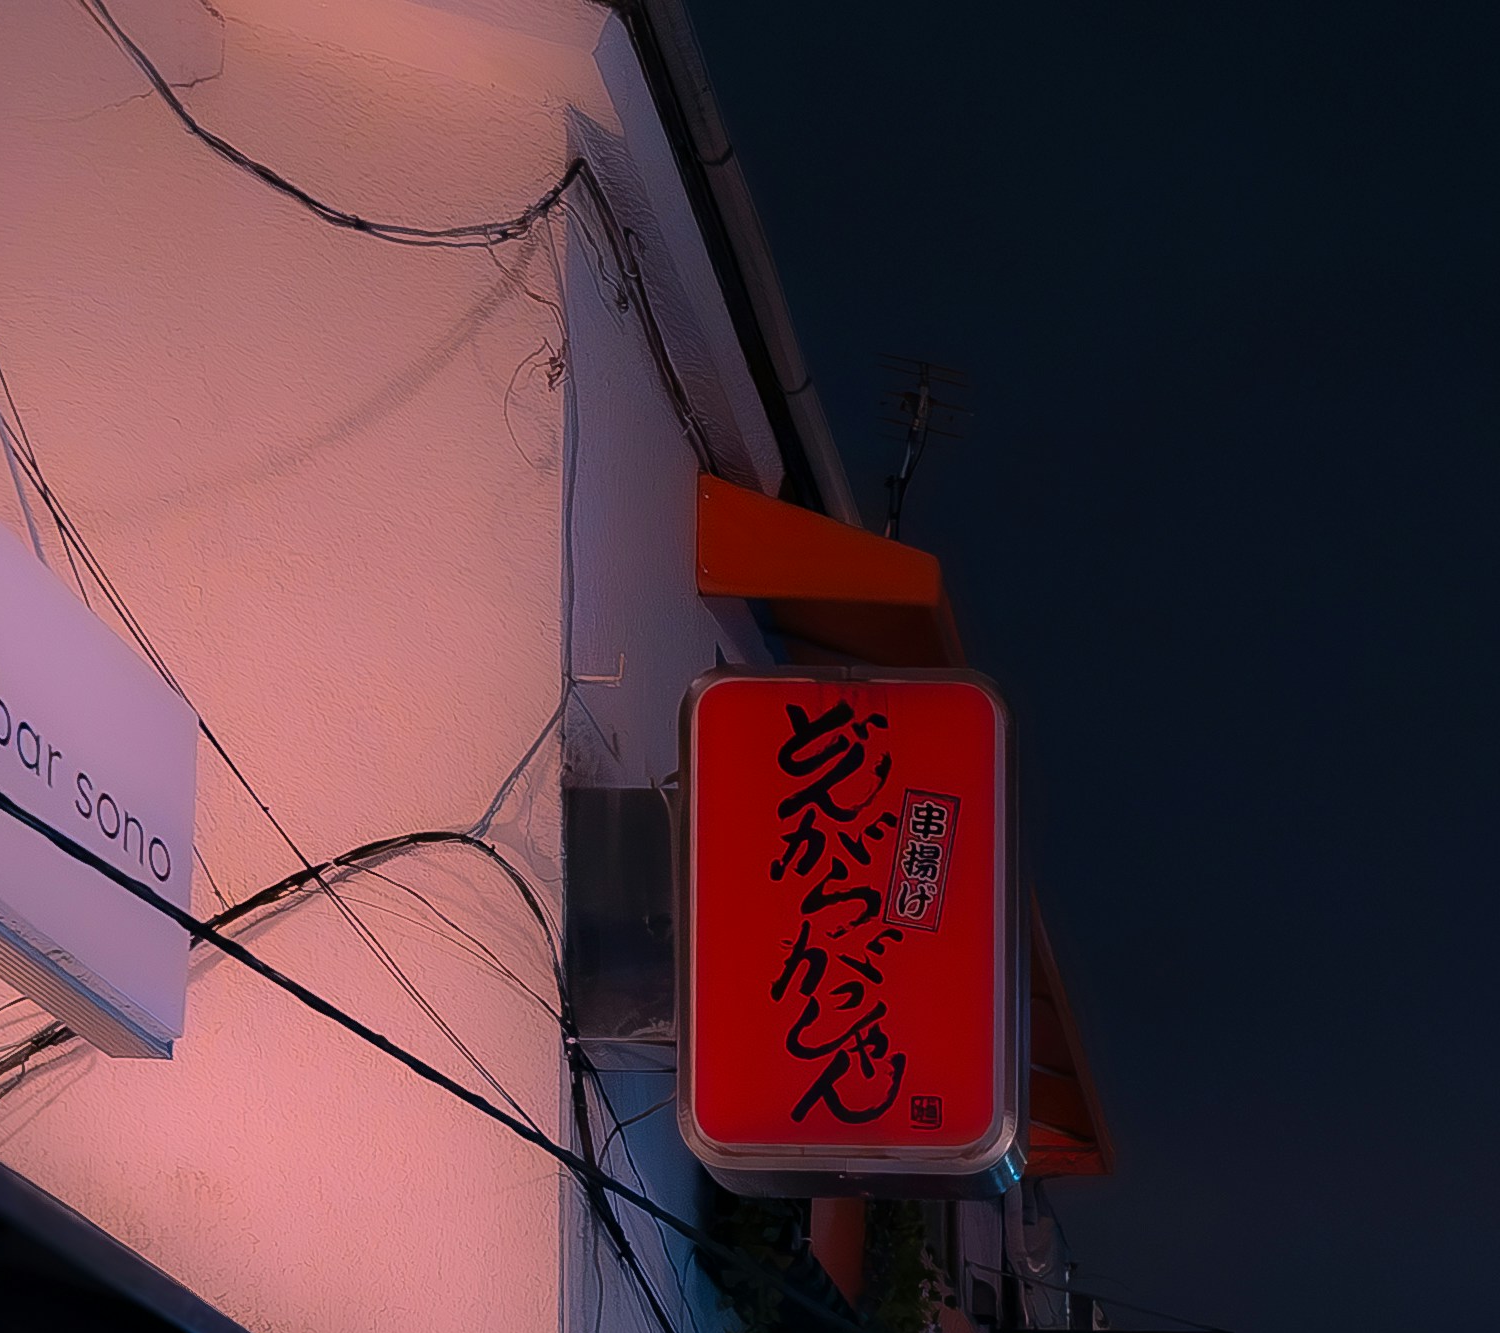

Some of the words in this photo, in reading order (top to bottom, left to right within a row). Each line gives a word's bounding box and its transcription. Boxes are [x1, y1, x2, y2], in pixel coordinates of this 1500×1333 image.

[74, 772, 173, 884] sono
[894, 799, 950, 920] 串揚げ
